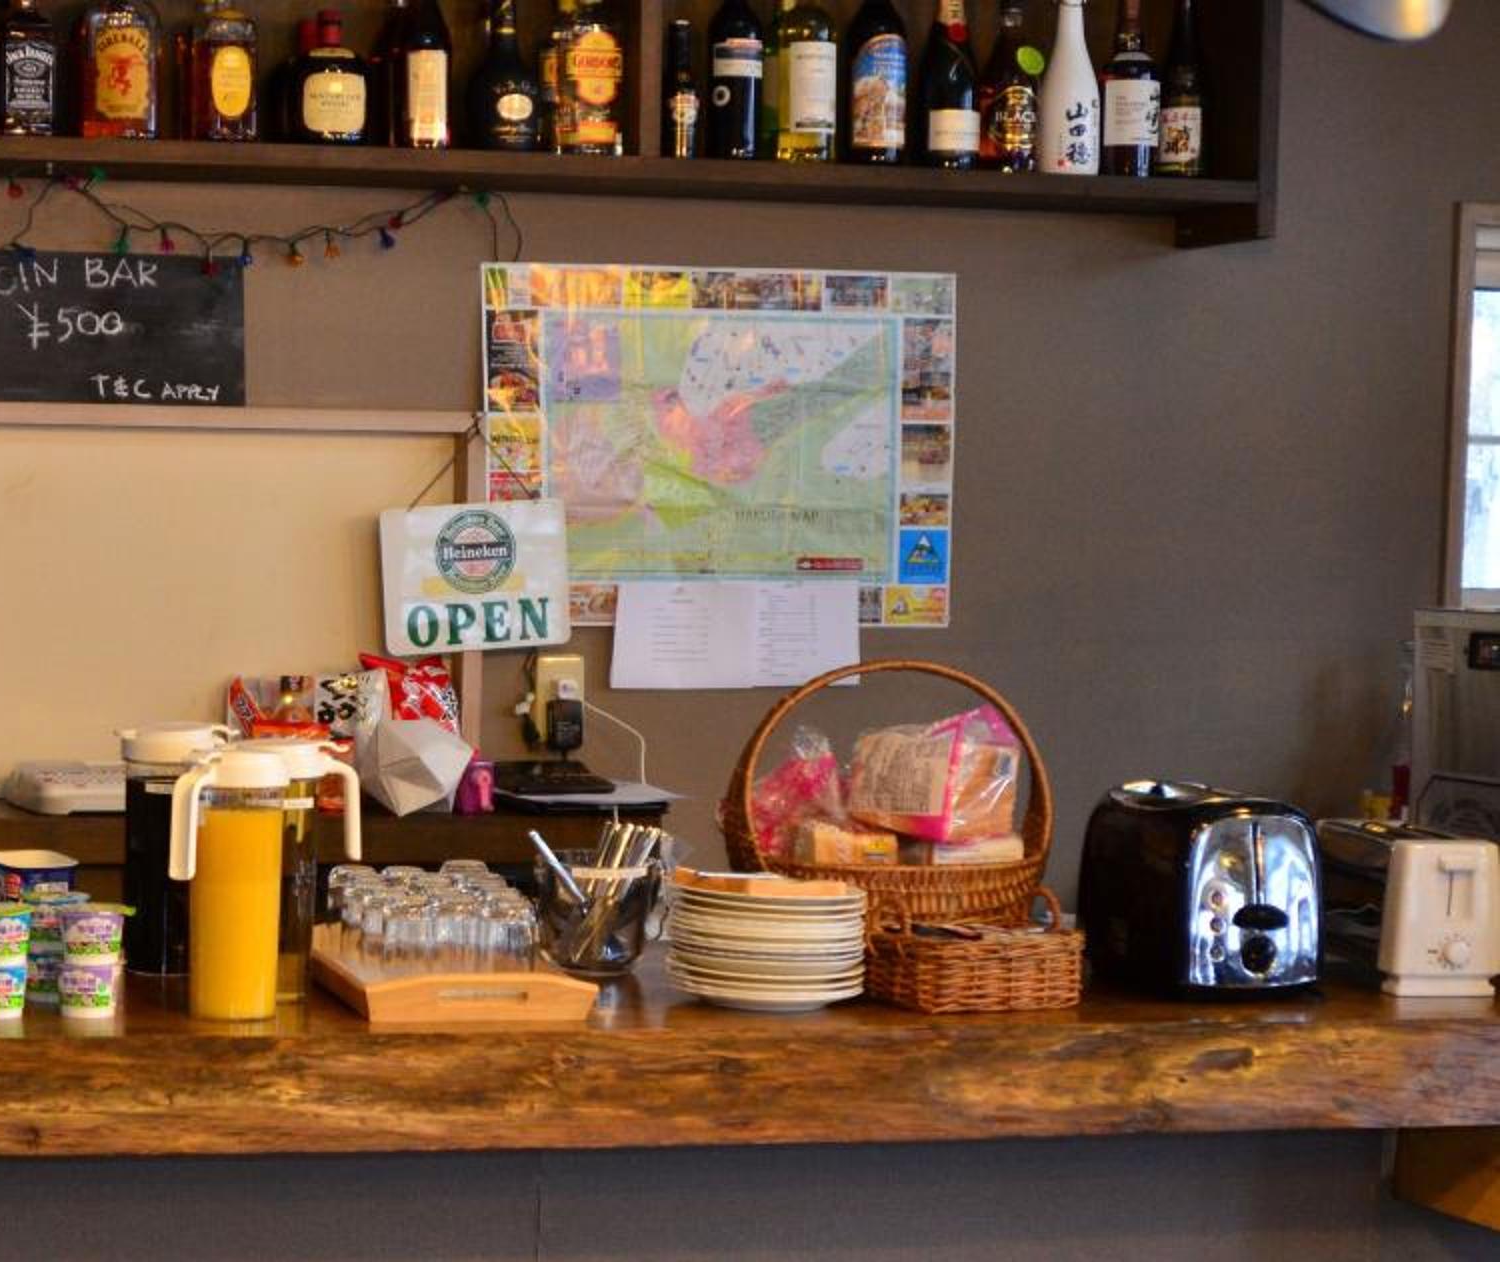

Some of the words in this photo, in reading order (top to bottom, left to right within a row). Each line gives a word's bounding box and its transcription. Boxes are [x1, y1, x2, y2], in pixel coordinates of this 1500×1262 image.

[85, 257, 158, 289] BAR
[162, 382, 221, 402] APPLY
[441, 544, 509, 561] Heineken
[406, 597, 549, 648] OPEN
